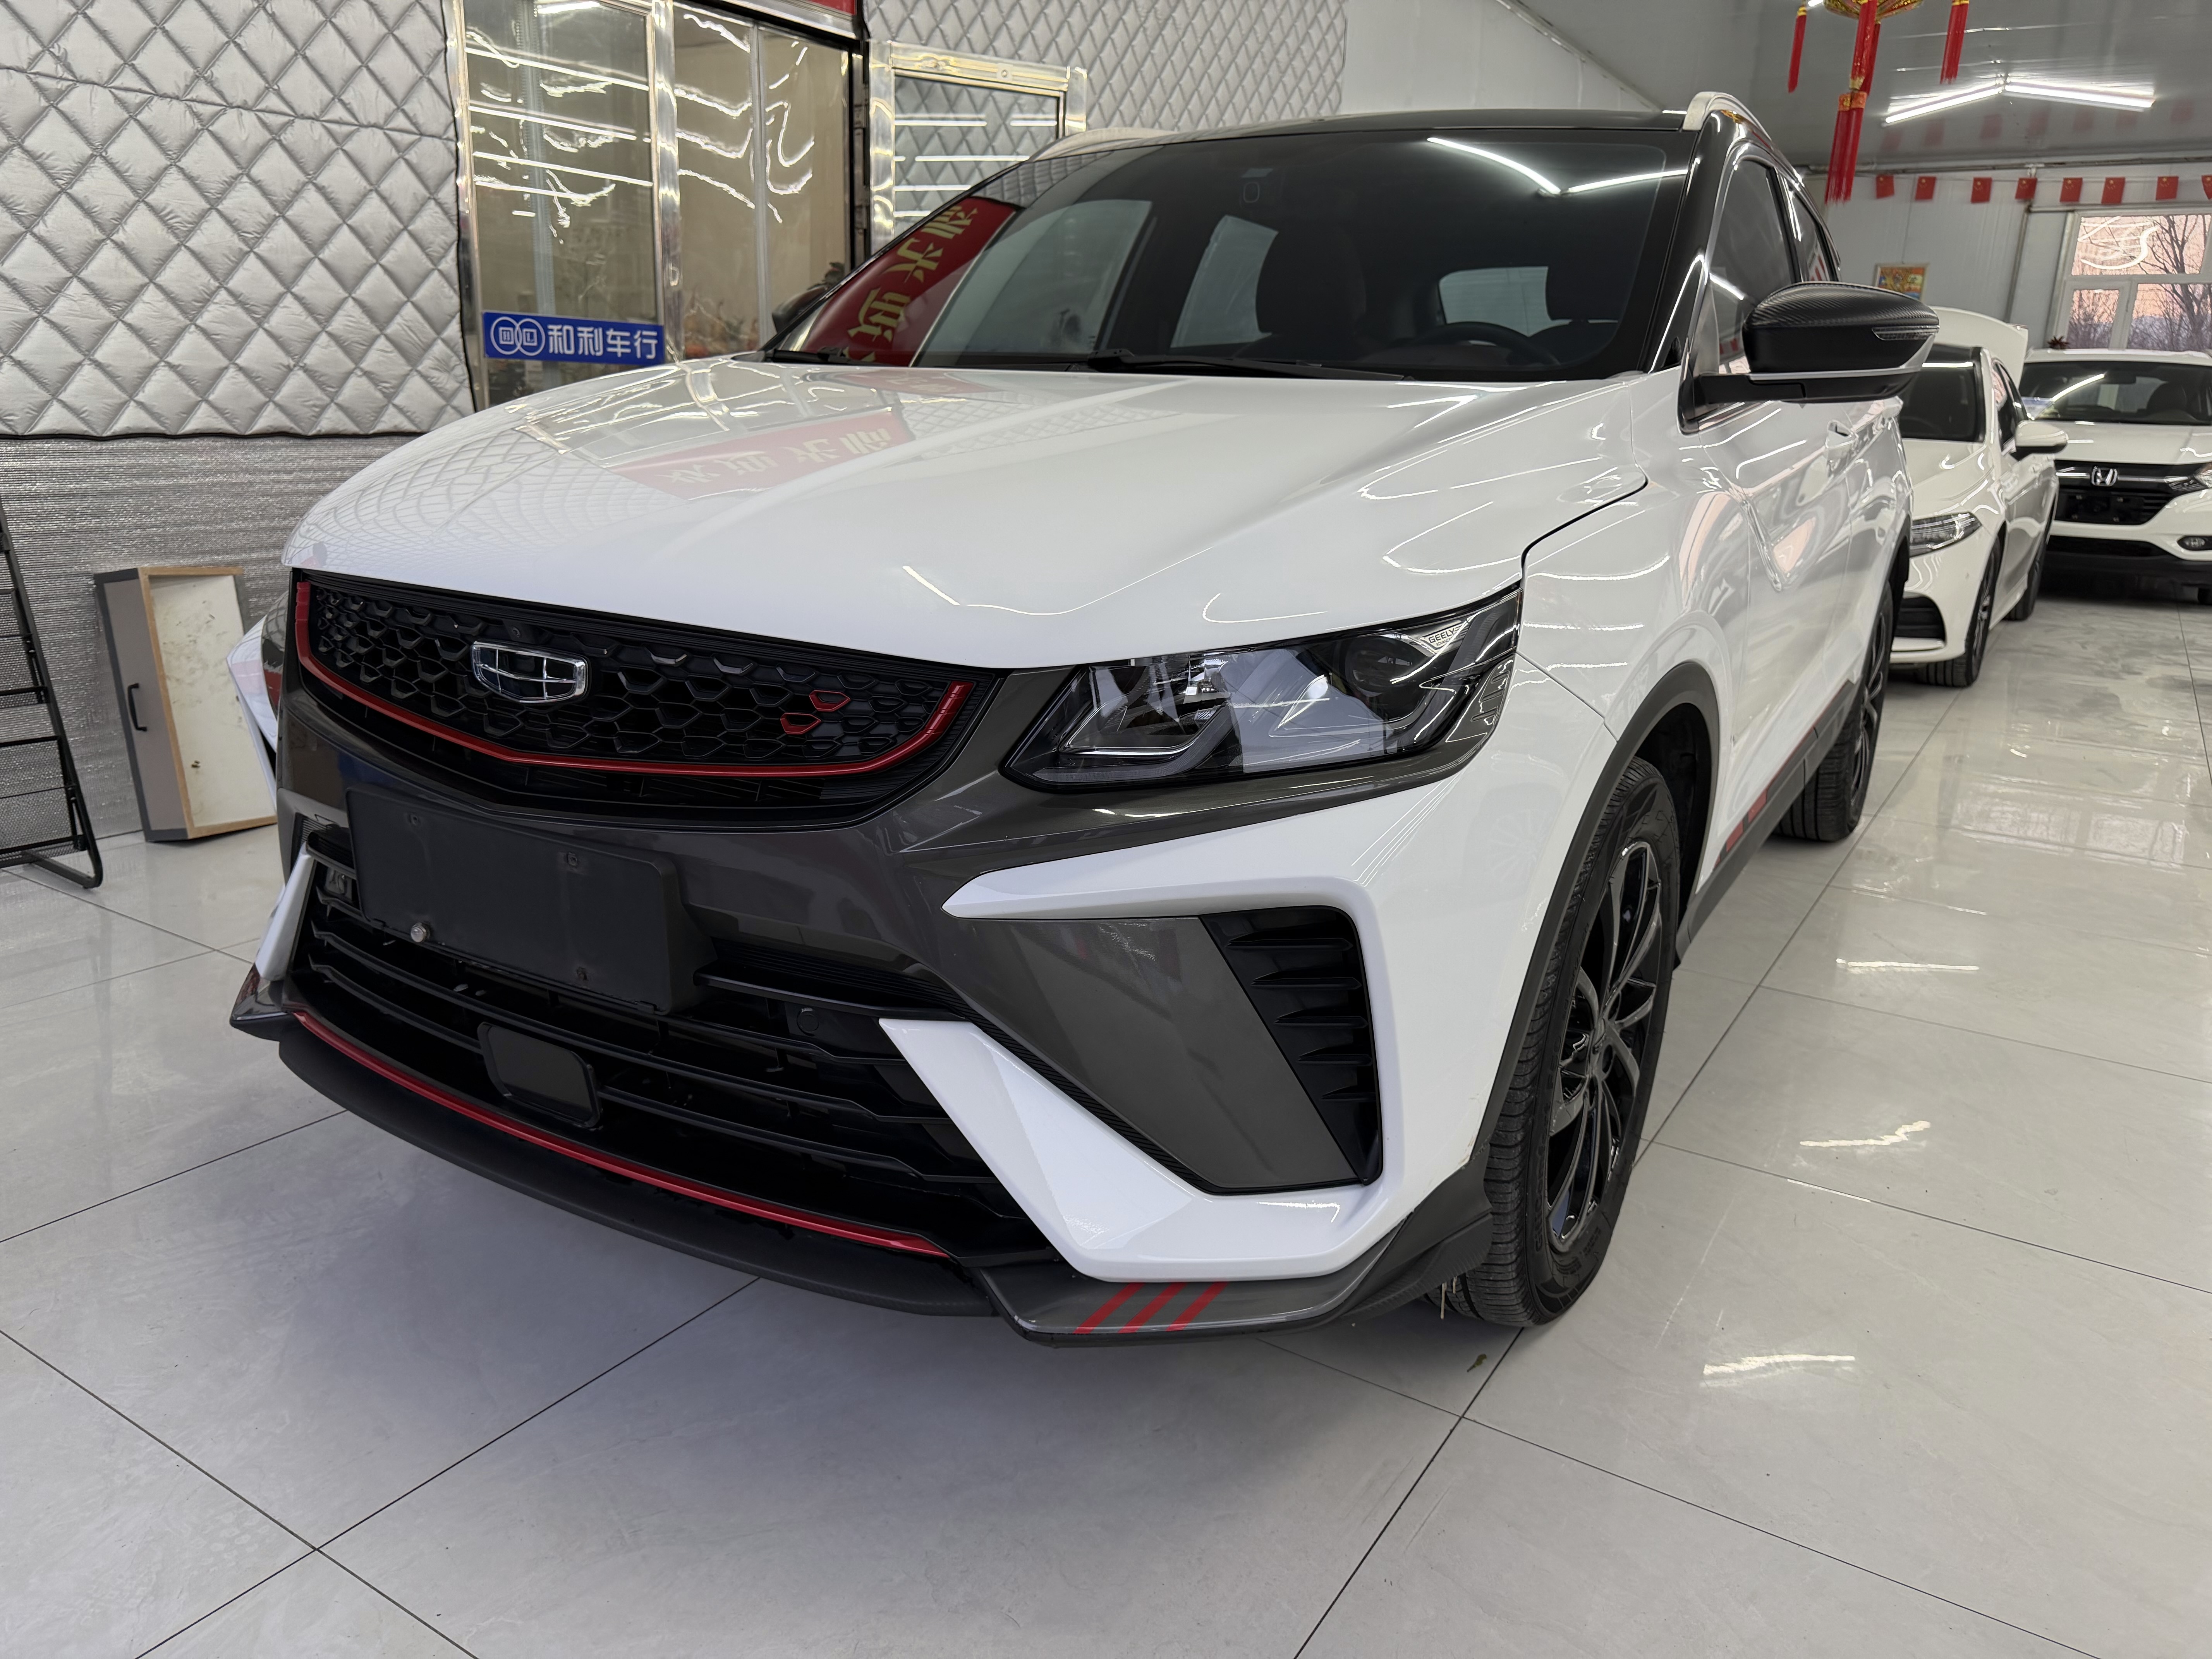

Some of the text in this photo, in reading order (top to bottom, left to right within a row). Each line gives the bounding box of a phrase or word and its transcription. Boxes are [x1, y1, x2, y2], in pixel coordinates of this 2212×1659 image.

[547, 324, 658, 359] 和利车行
[1428, 628, 1455, 643] GEELY
